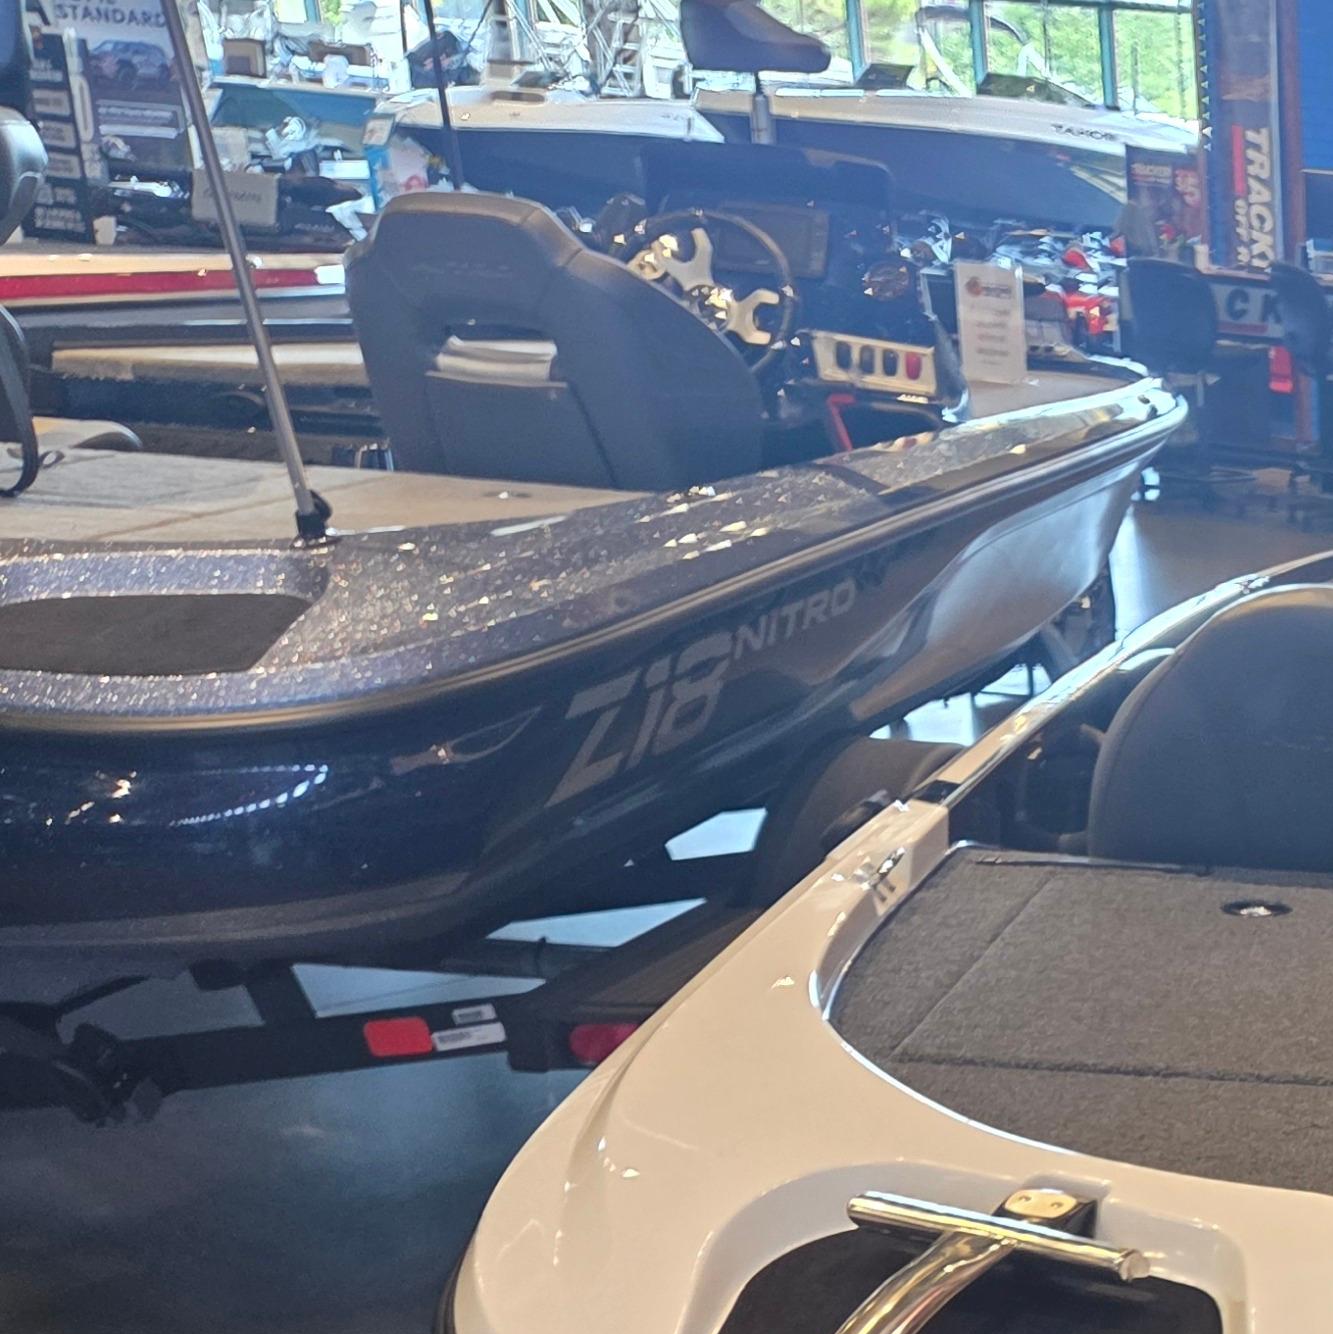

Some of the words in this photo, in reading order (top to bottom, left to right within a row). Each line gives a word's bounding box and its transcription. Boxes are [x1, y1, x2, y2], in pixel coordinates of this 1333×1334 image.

[54, 4, 166, 28] STANDARD
[1244, 127, 1276, 271] TRACK
[734, 577, 856, 660] NITRO
